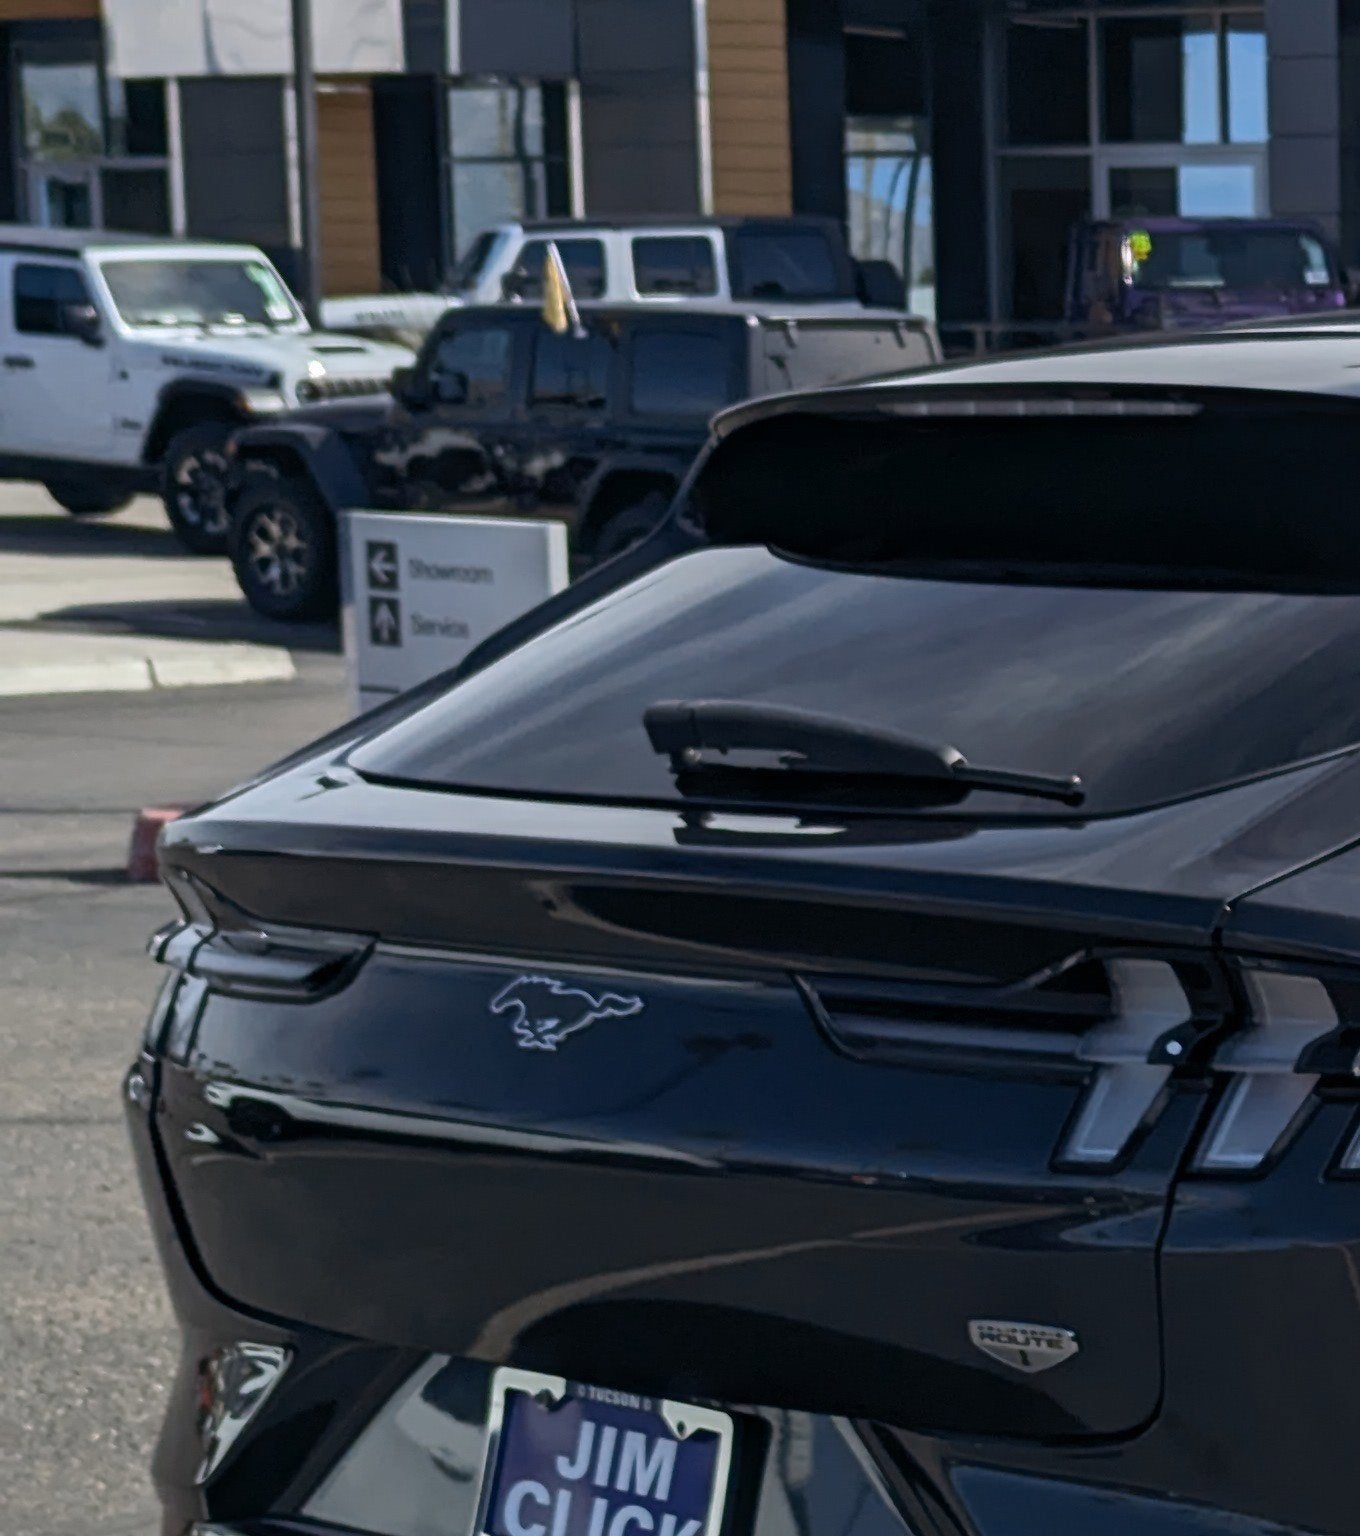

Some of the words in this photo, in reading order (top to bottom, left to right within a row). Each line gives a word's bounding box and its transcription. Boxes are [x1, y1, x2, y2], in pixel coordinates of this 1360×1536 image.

[408, 558, 494, 585] Showroom
[410, 612, 470, 639] Service
[556, 1420, 678, 1501] JIM
